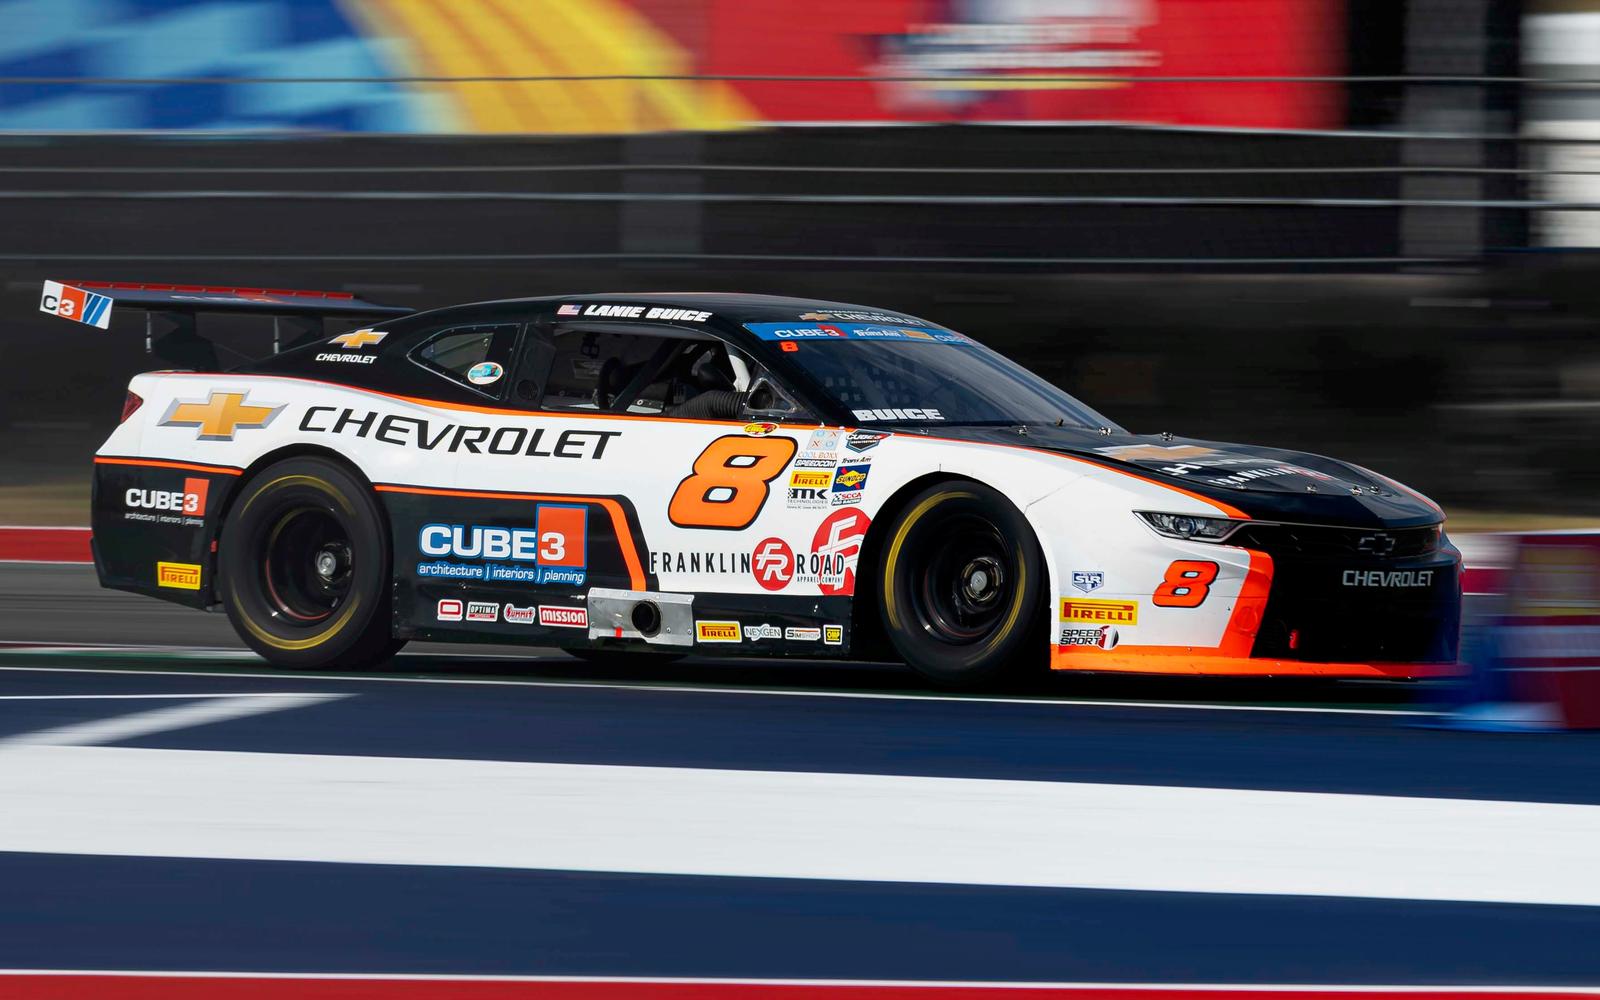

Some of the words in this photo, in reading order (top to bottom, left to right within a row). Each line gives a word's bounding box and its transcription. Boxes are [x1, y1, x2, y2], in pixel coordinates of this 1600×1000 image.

[584, 305, 645, 318] LANIE
[646, 308, 712, 322] BUICE
[774, 328, 840, 338] CUBE3
[315, 353, 377, 364] CHEVROLET
[852, 409, 945, 421] BUICE
[299, 406, 622, 460] CHEVROLET
[668, 434, 798, 531] 8
[794, 474, 830, 485] PIRELLI
[837, 474, 865, 483] SUNOCO
[125, 488, 199, 513] CUBE3
[421, 526, 565, 561] CUBE3
[650, 552, 750, 574] FRANKLIN
[797, 554, 844, 575] ROAD
[160, 566, 198, 585] PIRELLI
[419, 565, 482, 576] architecture
[493, 568, 534, 579] interiors
[544, 571, 584, 584] planning
[1342, 570, 1434, 587] CHEVROLET
[1152, 560, 1219, 608] 8
[470, 605, 495, 614] OPTIMA
[541, 611, 585, 623] MISSION
[1063, 602, 1134, 621] PIRELLI
[701, 626, 736, 637] PIRELLI
[1062, 629, 1102, 637] SPEED
[1060, 637, 1100, 645] SPORT
